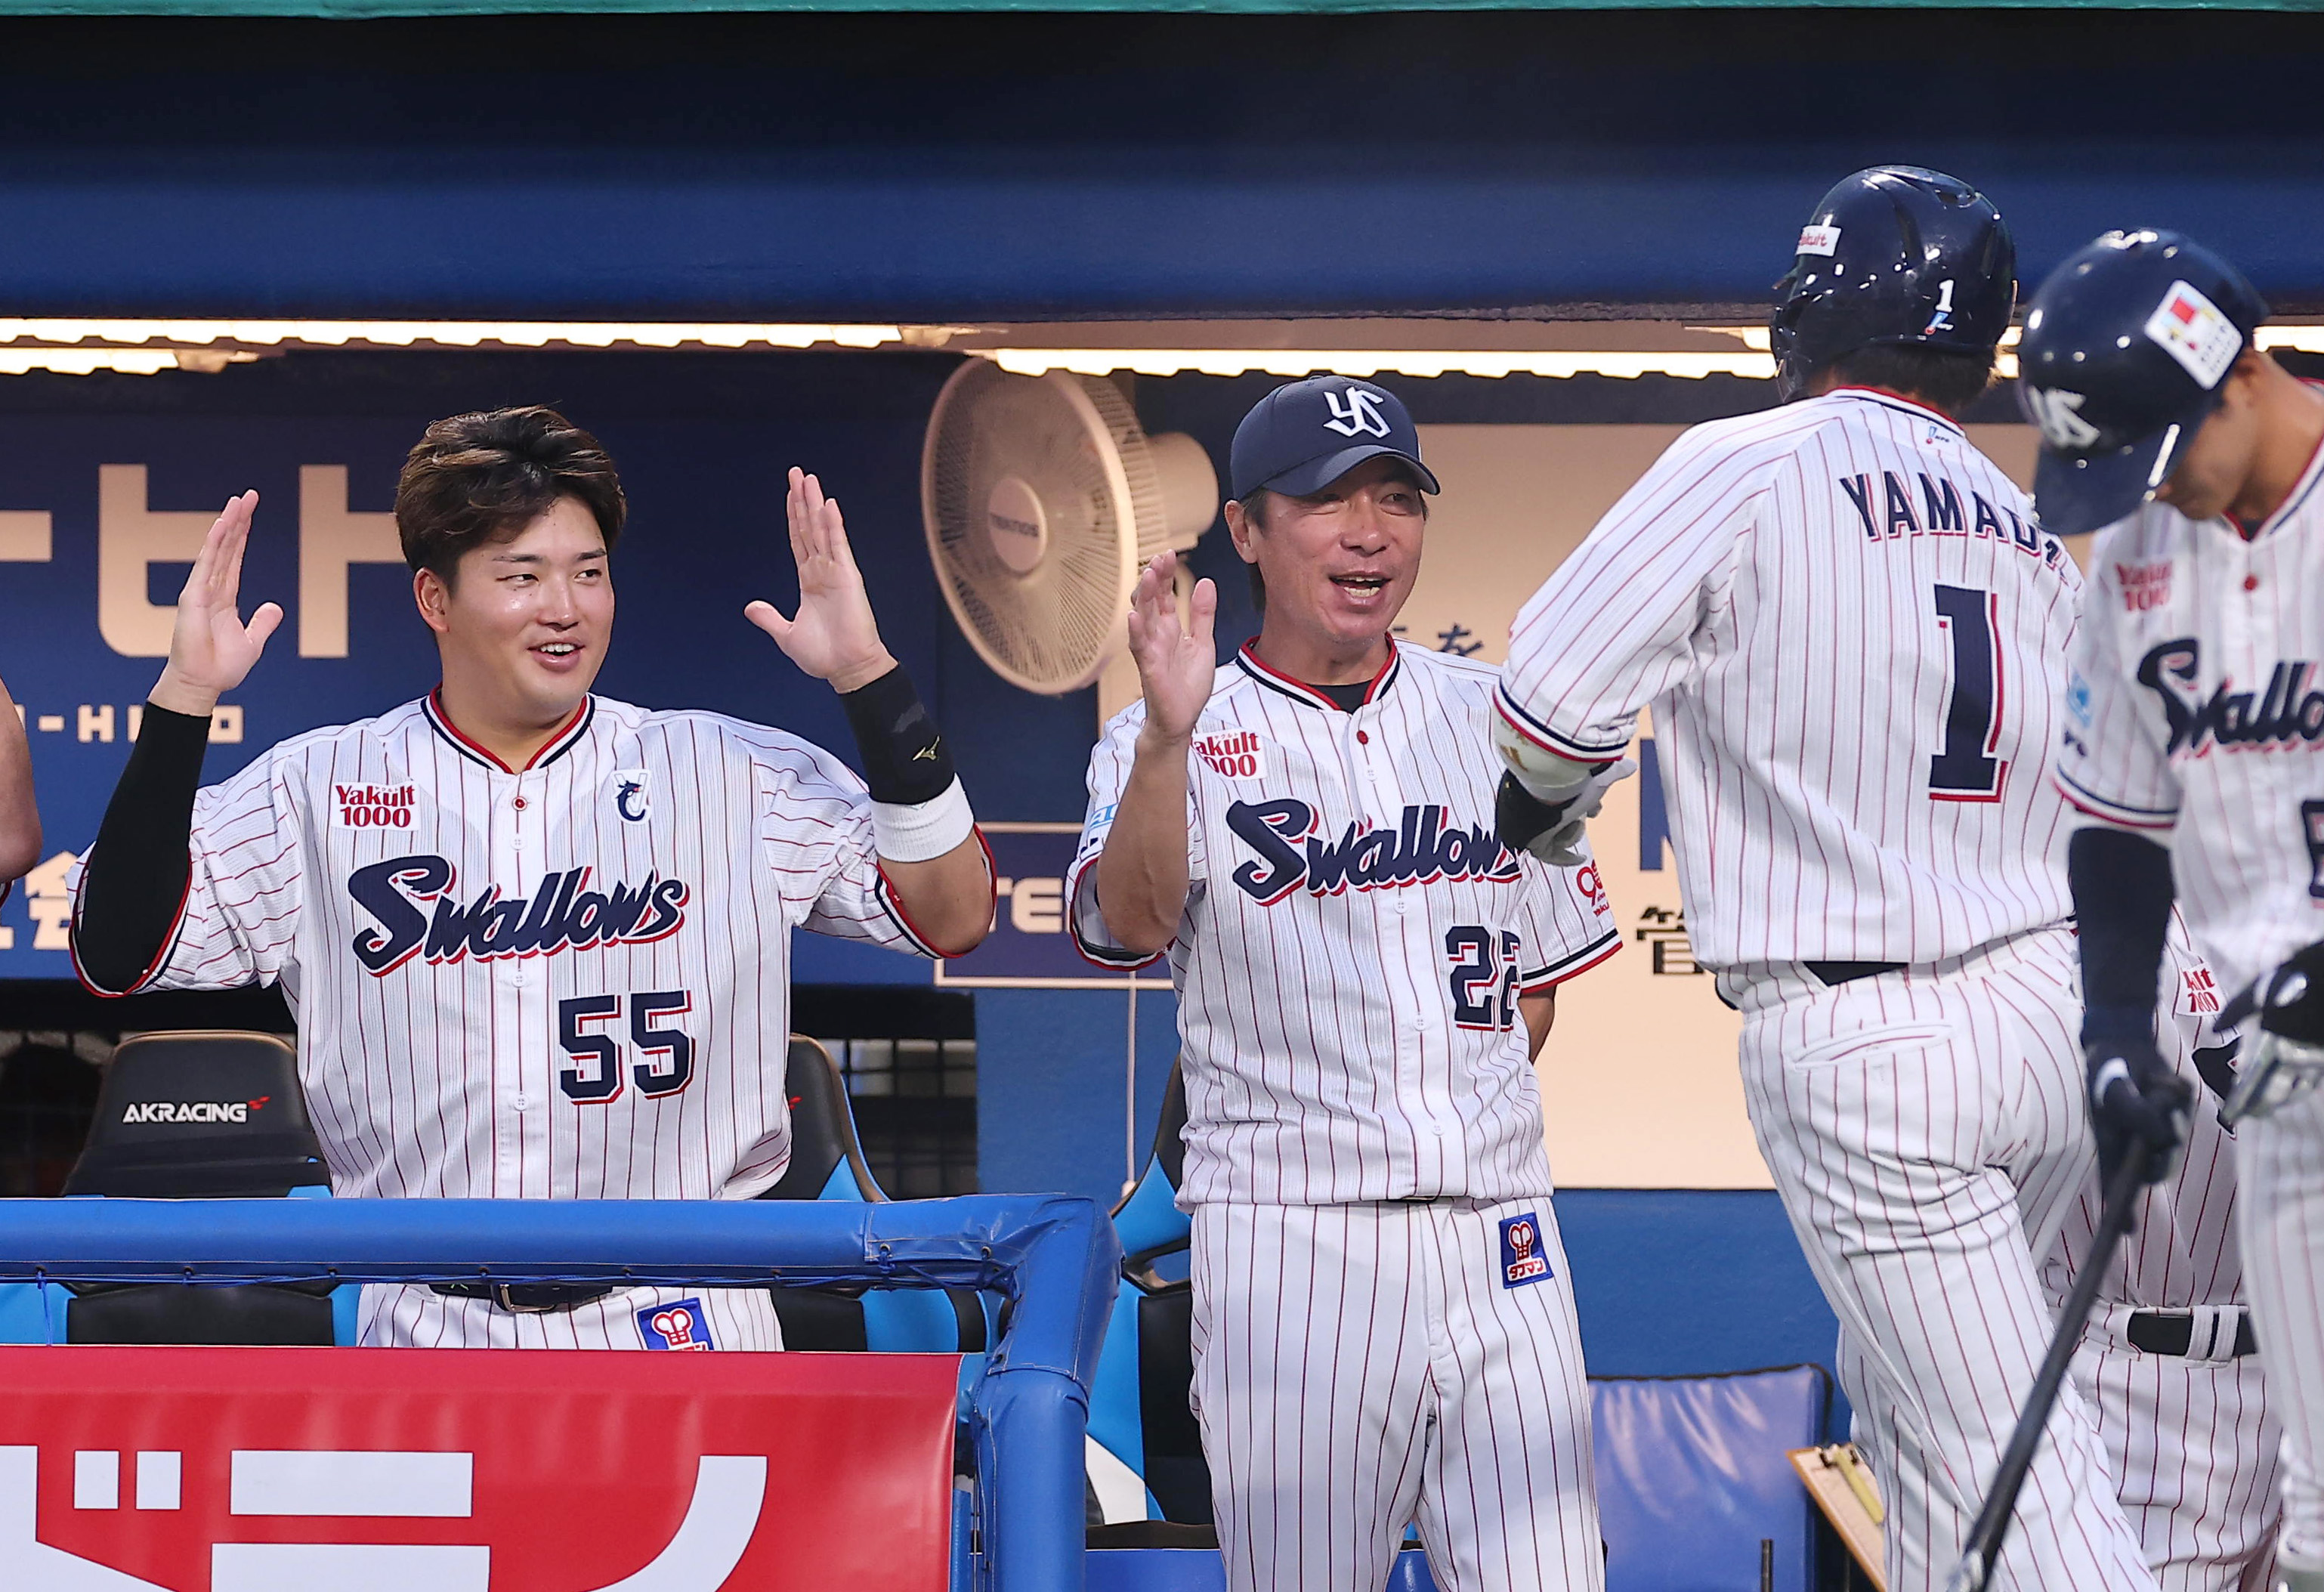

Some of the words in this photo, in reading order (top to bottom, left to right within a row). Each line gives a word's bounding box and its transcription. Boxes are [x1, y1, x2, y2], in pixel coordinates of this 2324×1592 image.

[1935, 279, 1955, 313] 1
[1928, 583, 2009, 803] 1
[335, 785, 416, 807] Yakult
[340, 806, 411, 828] 1000
[348, 855, 691, 978] Swallows
[558, 990, 696, 1105] 55
[122, 1102, 248, 1124] AKRACING
